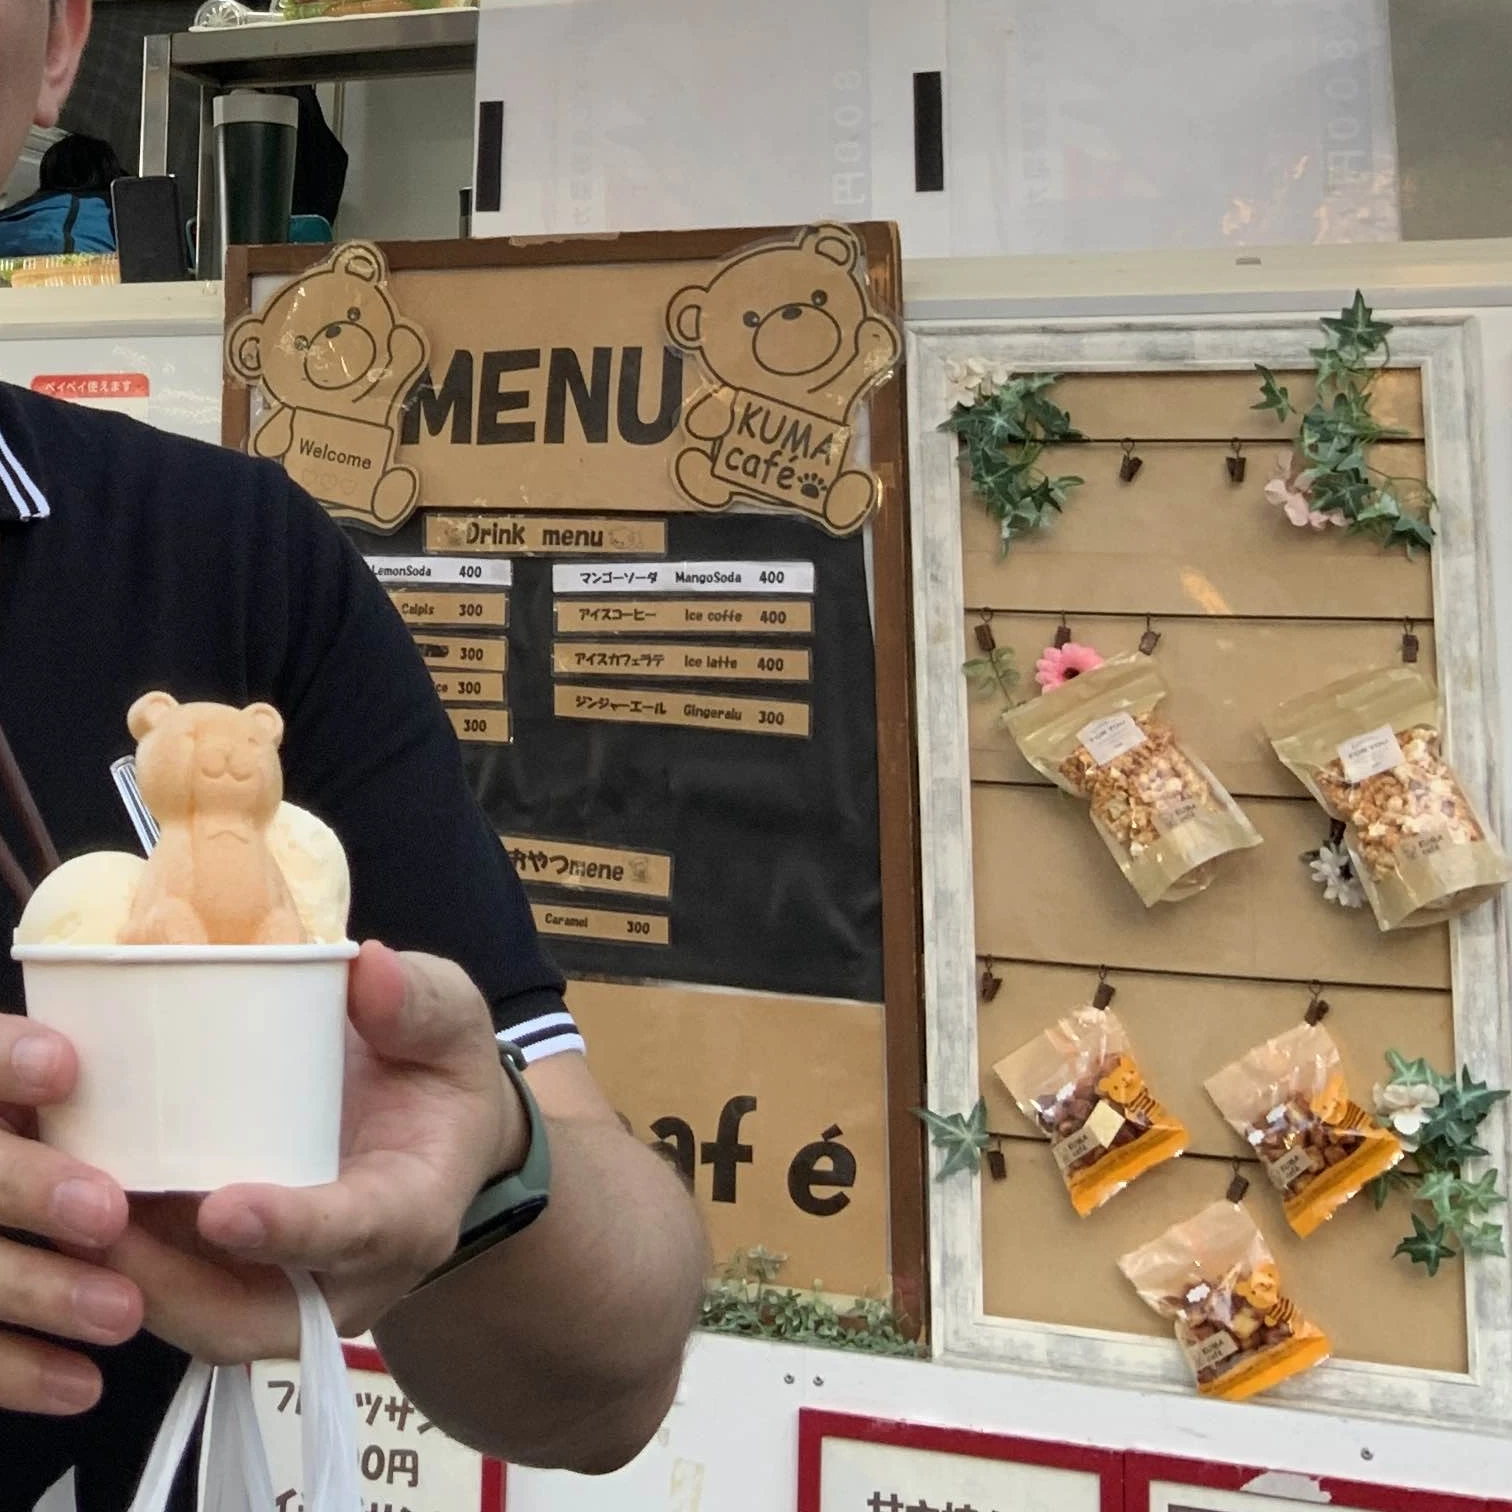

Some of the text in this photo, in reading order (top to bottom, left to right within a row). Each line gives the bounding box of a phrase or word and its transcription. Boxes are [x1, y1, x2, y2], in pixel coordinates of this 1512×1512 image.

[402, 347, 683, 445] MENU
[737, 400, 837, 466] KUMA
[298, 437, 373, 471] Welcome
[724, 445, 798, 491] café
[465, 521, 604, 548] Drink menu
[459, 565, 482, 578] 400
[580, 571, 785, 585] マンゴーソーダ MangoSoda 400
[459, 603, 483, 617] 300
[579, 608, 657, 621] アイスコーヒー
[685, 608, 703, 622] Ice
[759, 610, 787, 624] 400
[460, 647, 484, 661] 300
[575, 653, 784, 672] アイスカフェラテ Ice latte 400
[458, 681, 482, 695] 300
[575, 695, 667, 715] ジンジャーエール
[758, 710, 784, 726] 300
[463, 719, 487, 732] 300
[545, 913, 650, 935] Caramel 300
